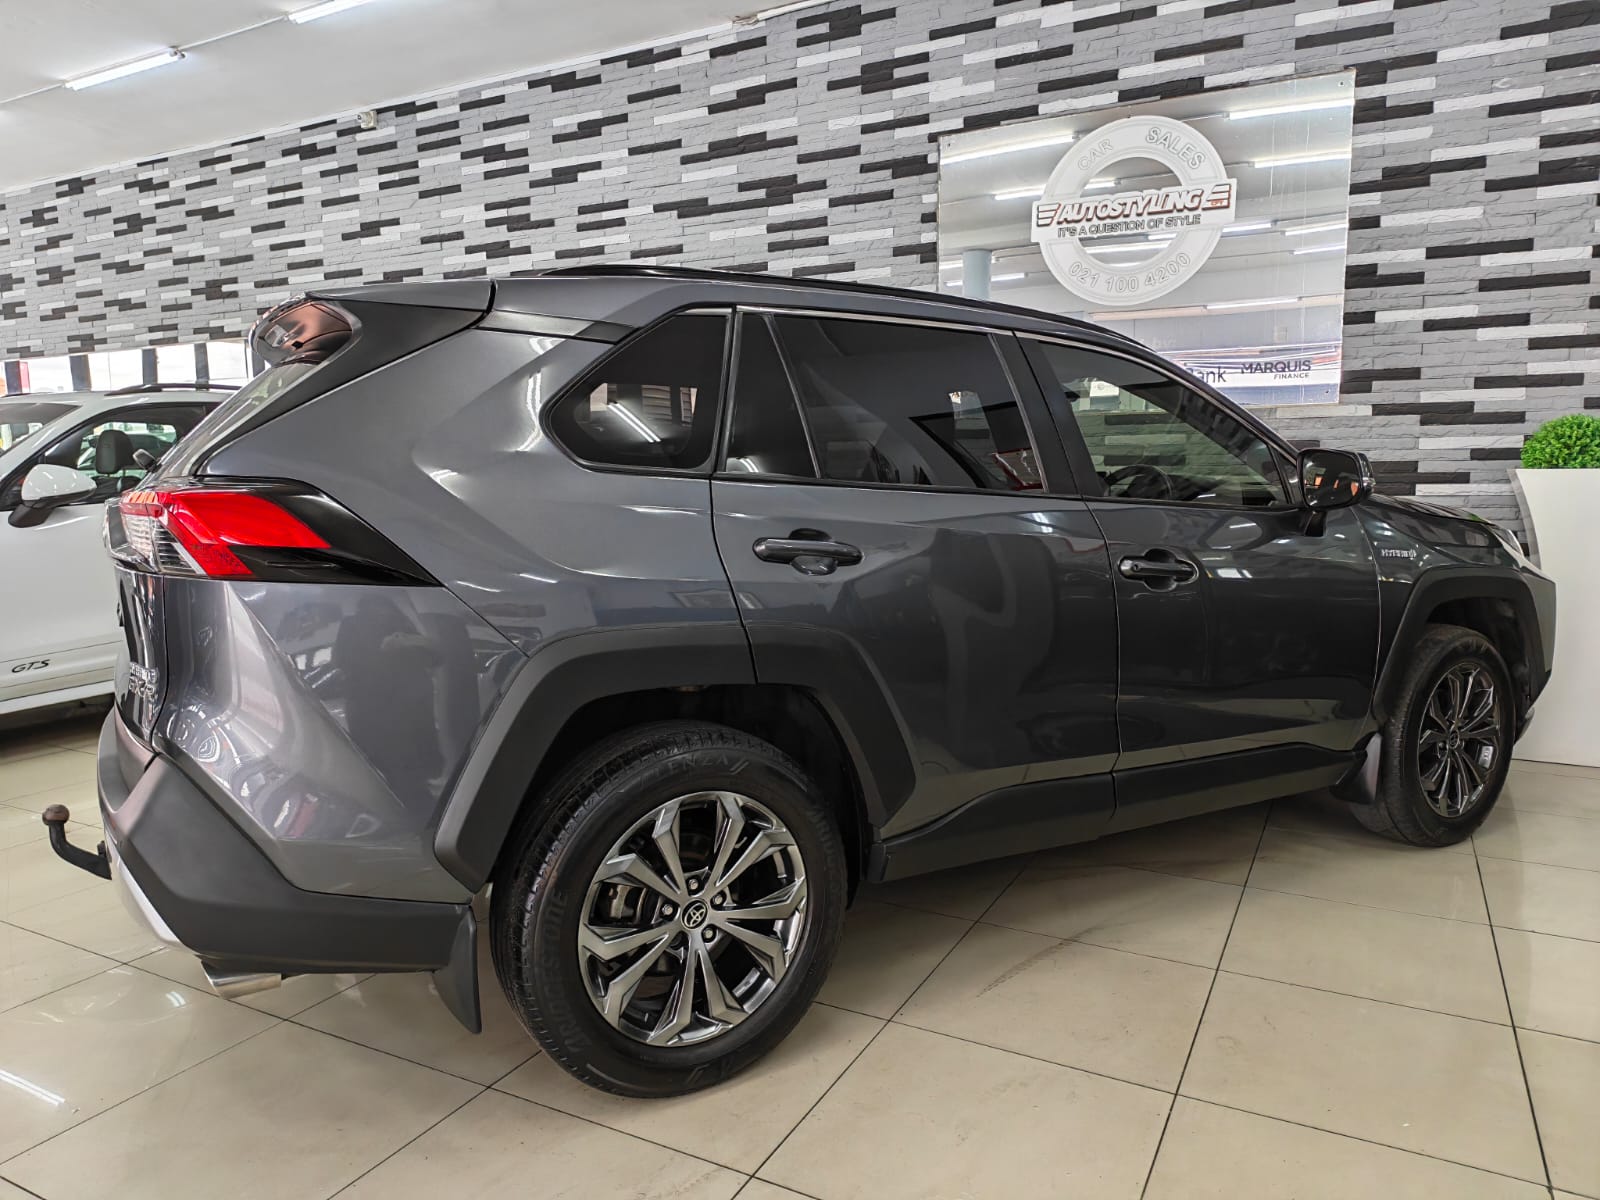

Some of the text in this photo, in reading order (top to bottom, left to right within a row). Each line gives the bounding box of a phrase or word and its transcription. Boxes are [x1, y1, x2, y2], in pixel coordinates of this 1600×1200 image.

[1078, 127, 1206, 170] CAR SALES
[1056, 189, 1204, 224] AUTOSTYLING
[1057, 214, 1202, 238] IT'S A QUESTION OF STYLE
[1069, 252, 1191, 293] 021 100 4200
[1241, 360, 1312, 374] MARQUIS
[1273, 372, 1310, 381] FINANCE
[11, 658, 51, 674] GTS
